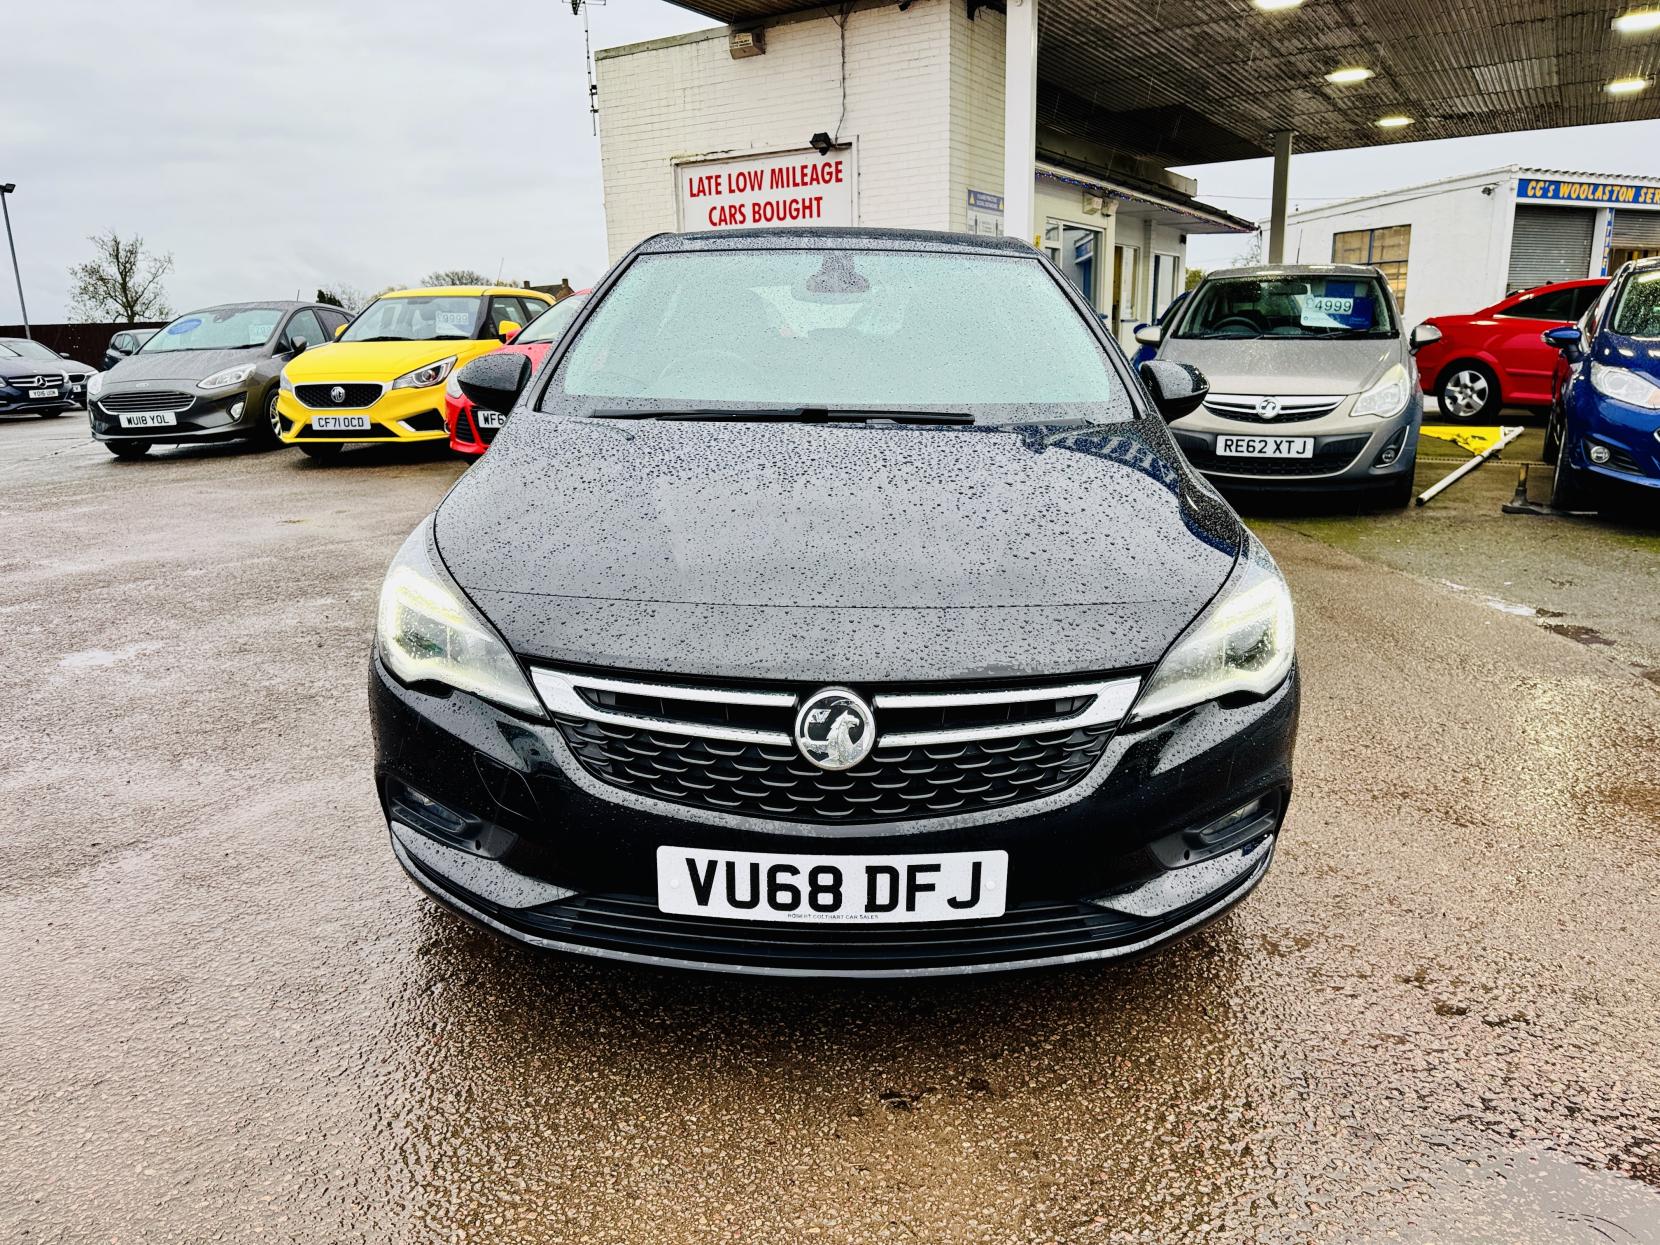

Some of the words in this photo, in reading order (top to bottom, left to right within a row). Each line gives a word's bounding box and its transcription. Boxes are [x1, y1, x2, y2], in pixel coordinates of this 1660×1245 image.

[689, 174, 722, 198] LATE
[728, 169, 764, 194] LOW
[770, 160, 843, 190] MILEAGE
[1559, 182, 1635, 203] WOOLASTON
[708, 203, 747, 227] CARS
[752, 196, 823, 223] BOUGHT
[126, 415, 148, 426] WU18
[149, 414, 170, 425] YOL
[318, 417, 341, 428] CF71
[343, 417, 364, 428] OCD
[1223, 438, 1268, 454] RE62
[1273, 439, 1307, 455] XTJ
[685, 857, 843, 913] VU68
[864, 861, 982, 913] DFJ
